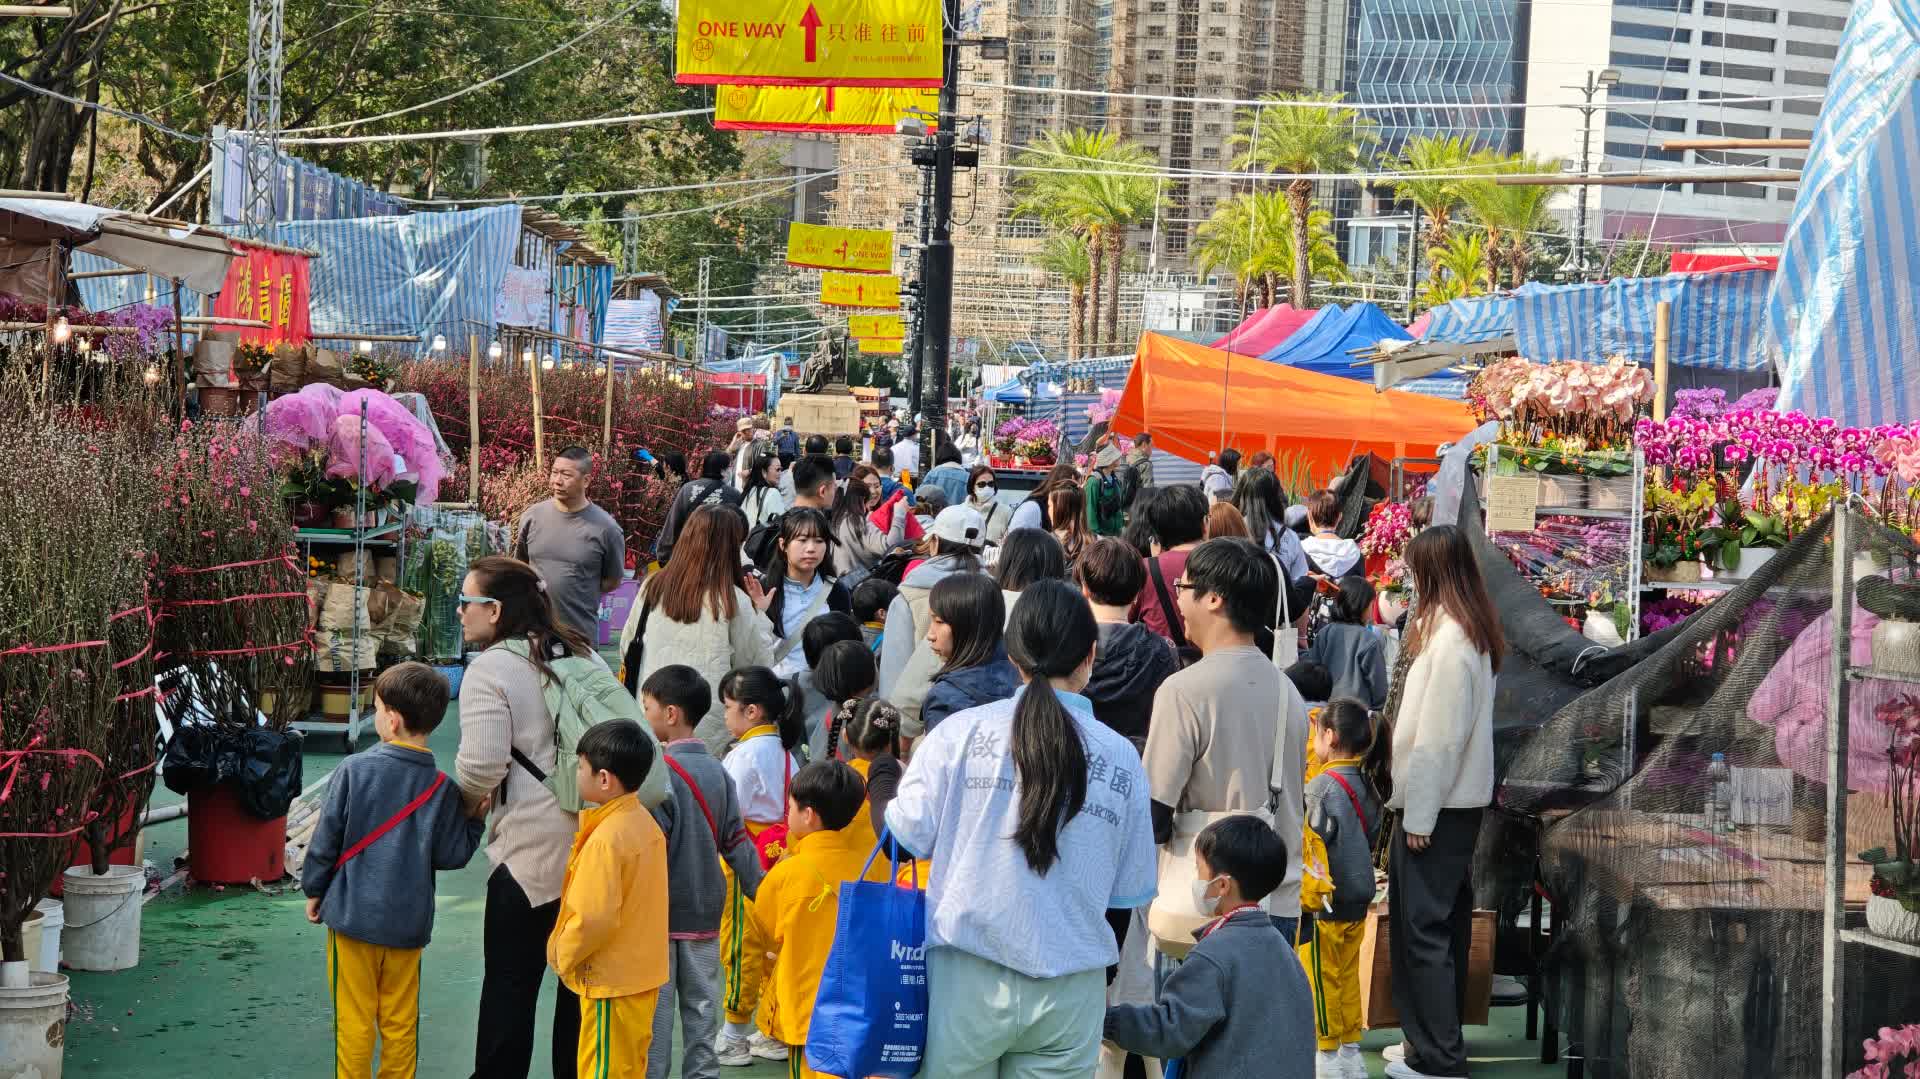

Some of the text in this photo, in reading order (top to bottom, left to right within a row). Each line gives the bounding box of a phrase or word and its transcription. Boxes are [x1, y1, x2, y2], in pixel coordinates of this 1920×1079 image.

[698, 21, 787, 39] ONE WAY
[828, 23, 928, 43] 只准往前
